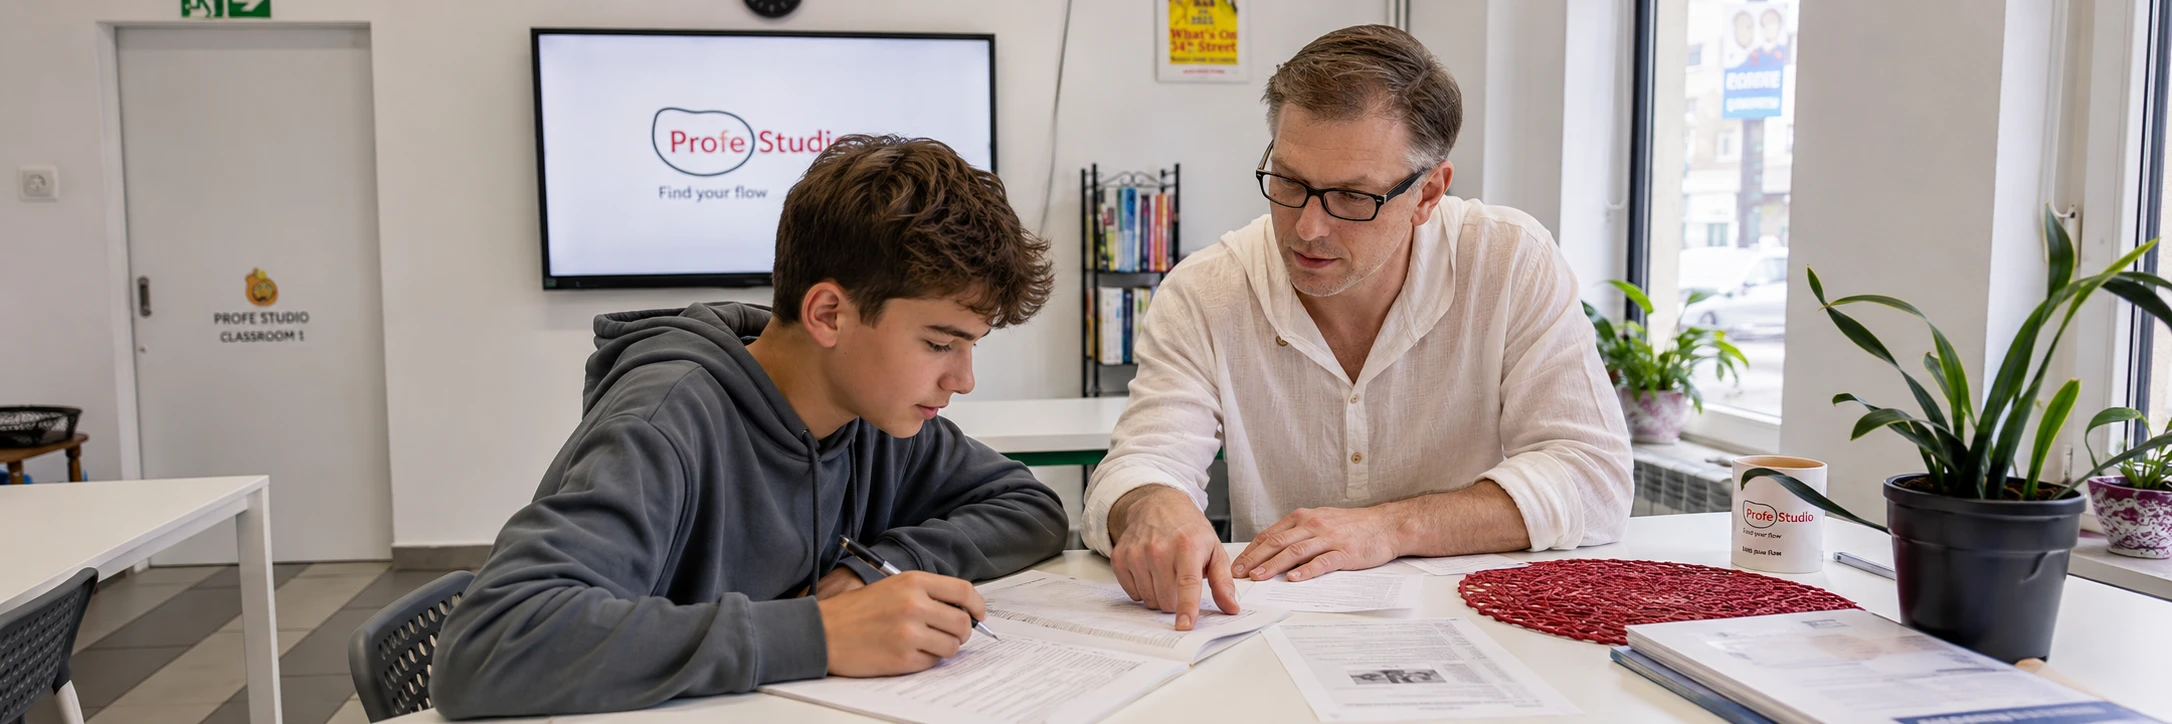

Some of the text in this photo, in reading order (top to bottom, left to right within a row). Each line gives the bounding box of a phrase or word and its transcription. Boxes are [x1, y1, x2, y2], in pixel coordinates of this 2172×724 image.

[1198, 41, 1237, 53] Street
[669, 130, 745, 153] Profe
[658, 186, 767, 202] Find your flow
[214, 311, 310, 324] PROFE STUDIO
[220, 330, 304, 342] CLASSROOM 1
[1746, 508, 1814, 522] Profe Studio
